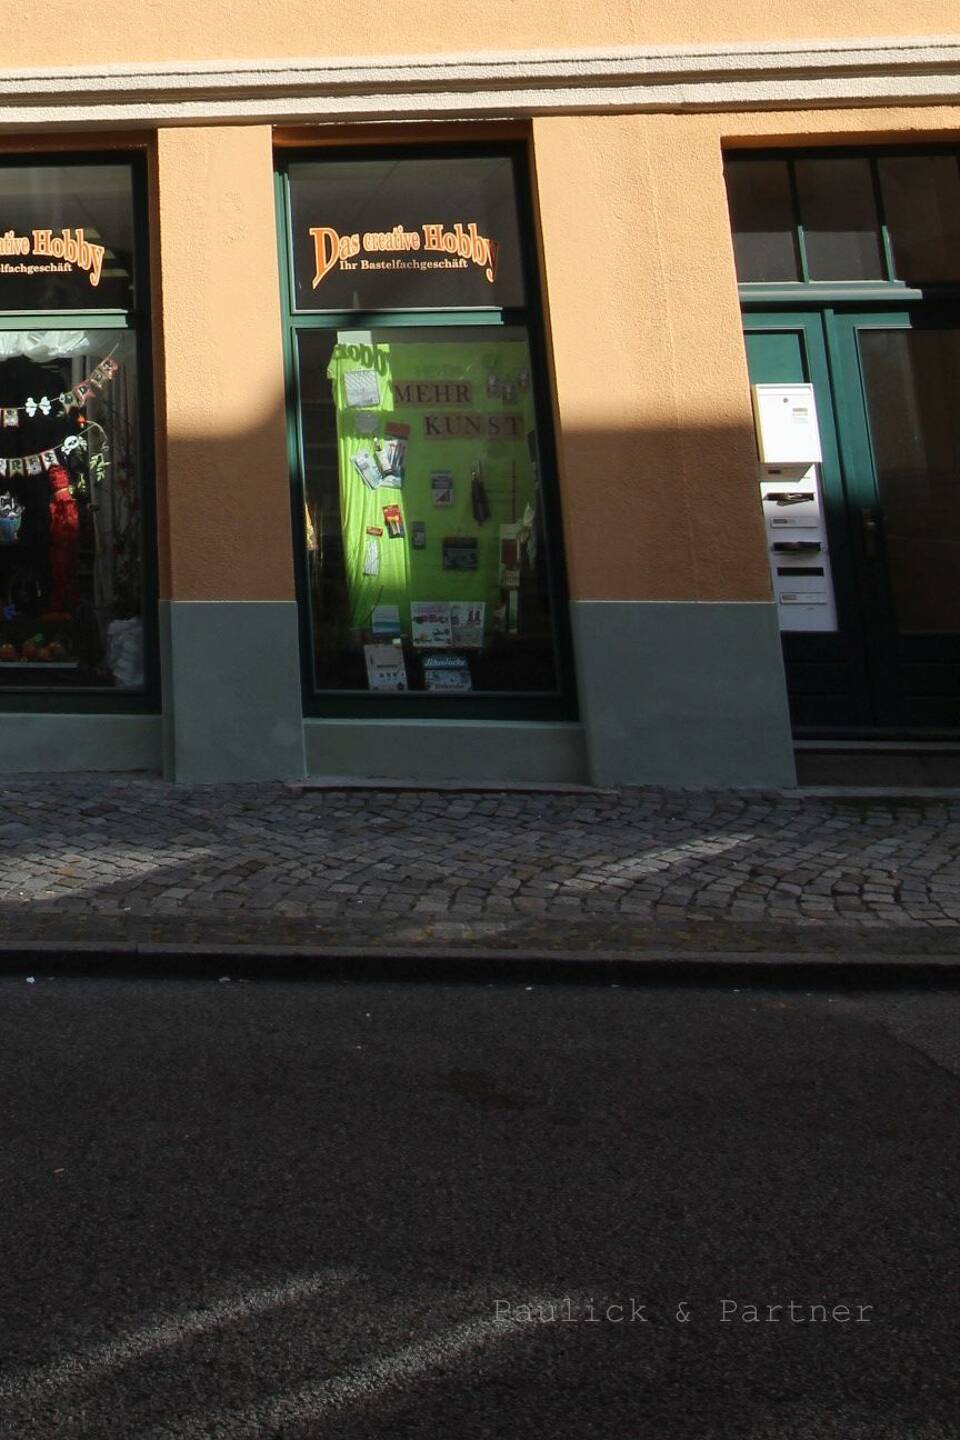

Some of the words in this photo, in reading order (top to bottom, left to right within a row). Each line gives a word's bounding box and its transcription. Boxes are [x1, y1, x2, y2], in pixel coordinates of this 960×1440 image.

[32, 228, 105, 287] Hobby
[309, 227, 360, 290] Das
[363, 225, 420, 251] creative
[422, 223, 497, 283] Hobby
[340, 260, 356, 270] Ihr
[361, 258, 468, 271] Bastelfachgeschäft
[395, 384, 470, 404] MEHR
[424, 416, 522, 436] KUNST
